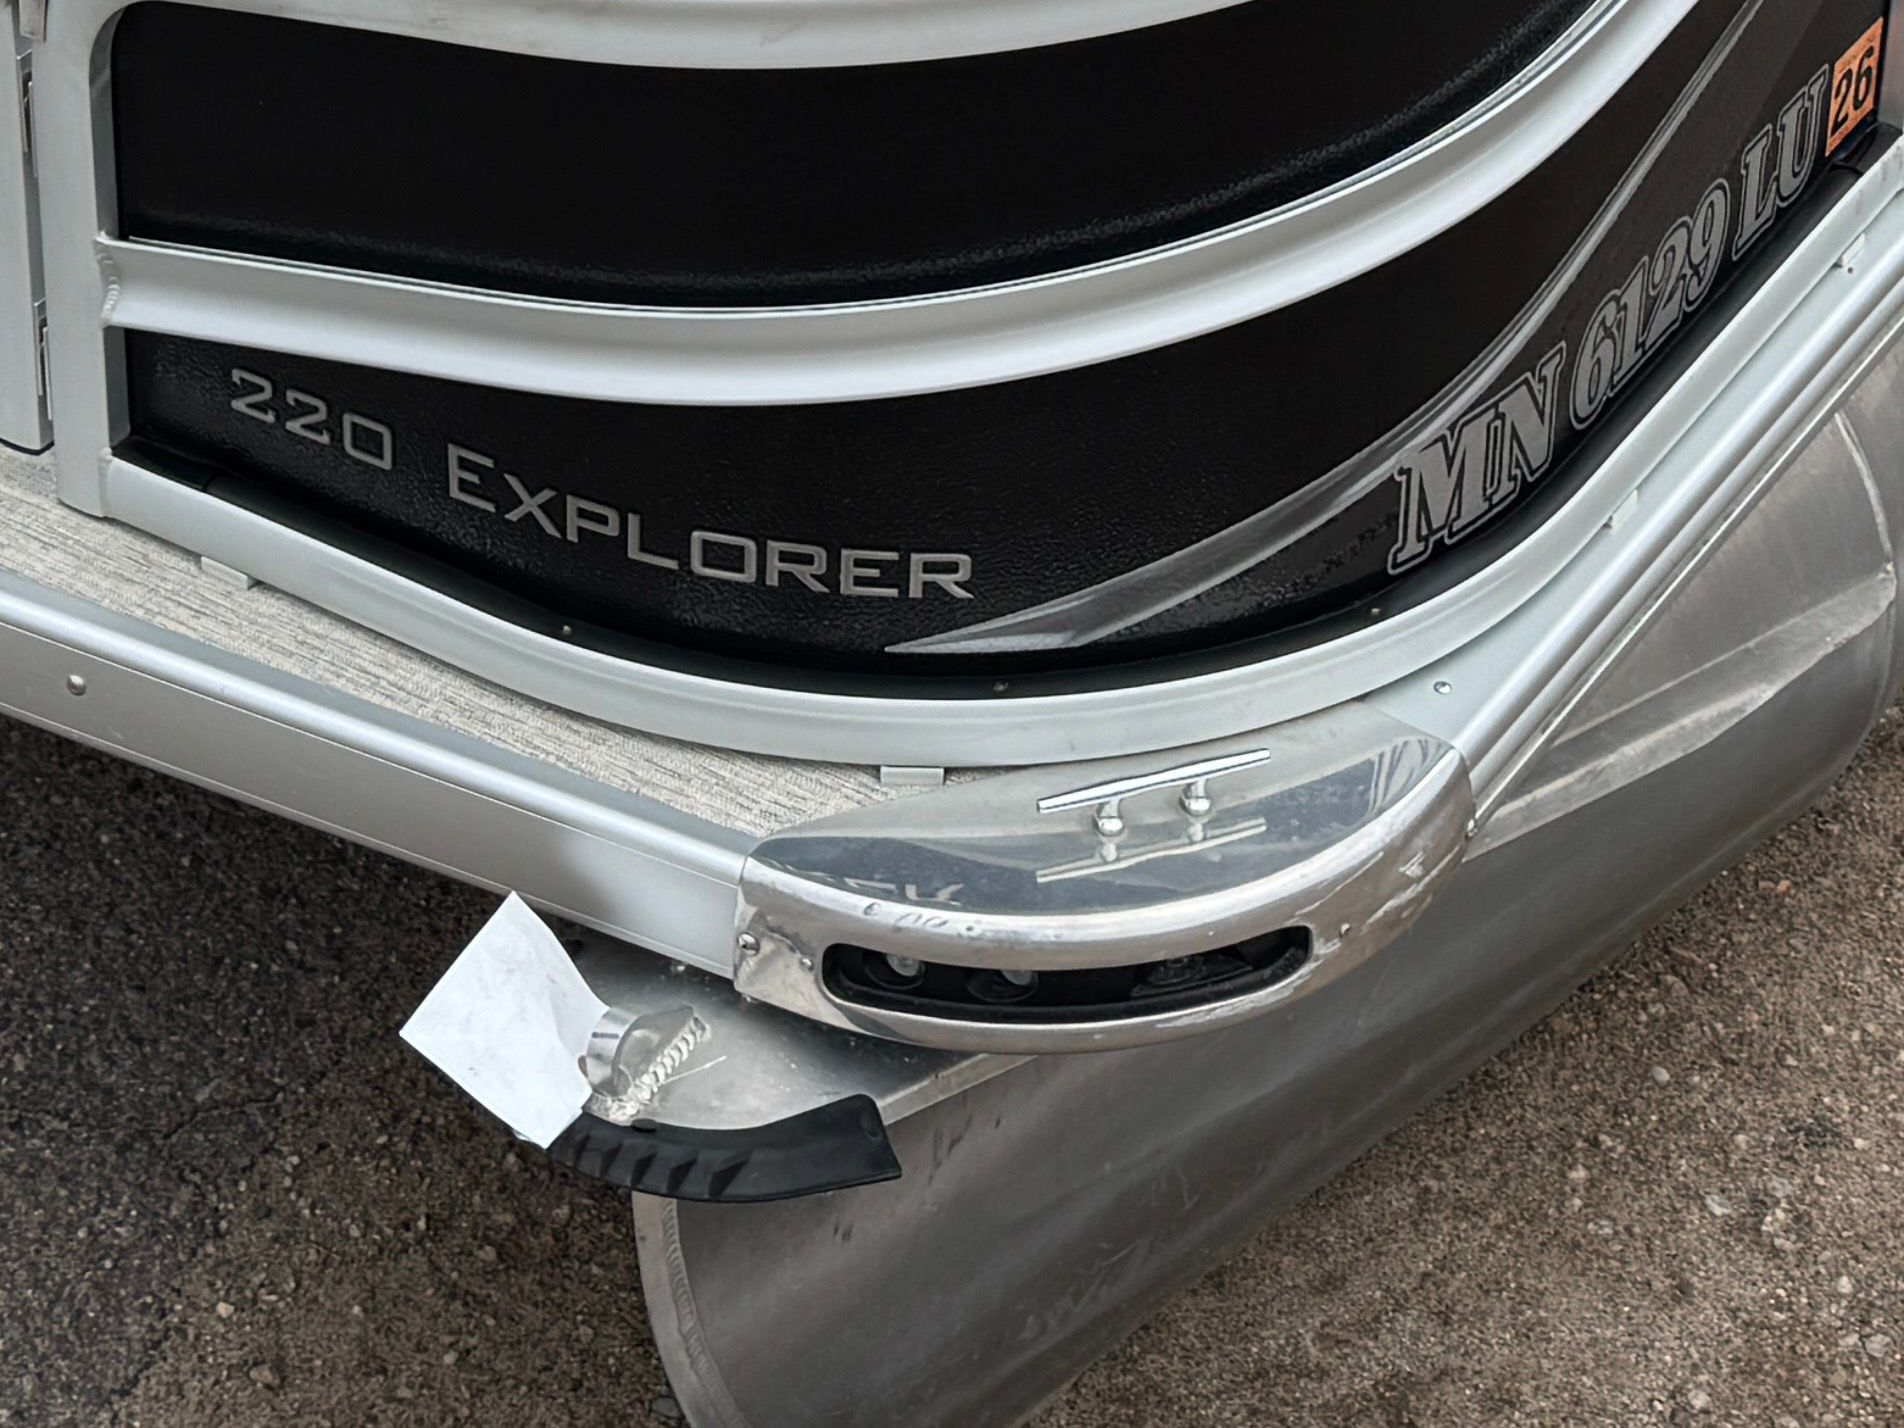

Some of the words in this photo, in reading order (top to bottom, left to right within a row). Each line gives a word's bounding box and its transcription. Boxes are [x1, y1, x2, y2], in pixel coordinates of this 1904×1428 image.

[1831, 45, 1875, 139] 26
[1387, 341, 1567, 575] MN
[1569, 178, 1731, 431] 6129
[1731, 63, 1829, 261] LU
[230, 367, 394, 471] 220
[446, 441, 974, 600] EXPLORER
